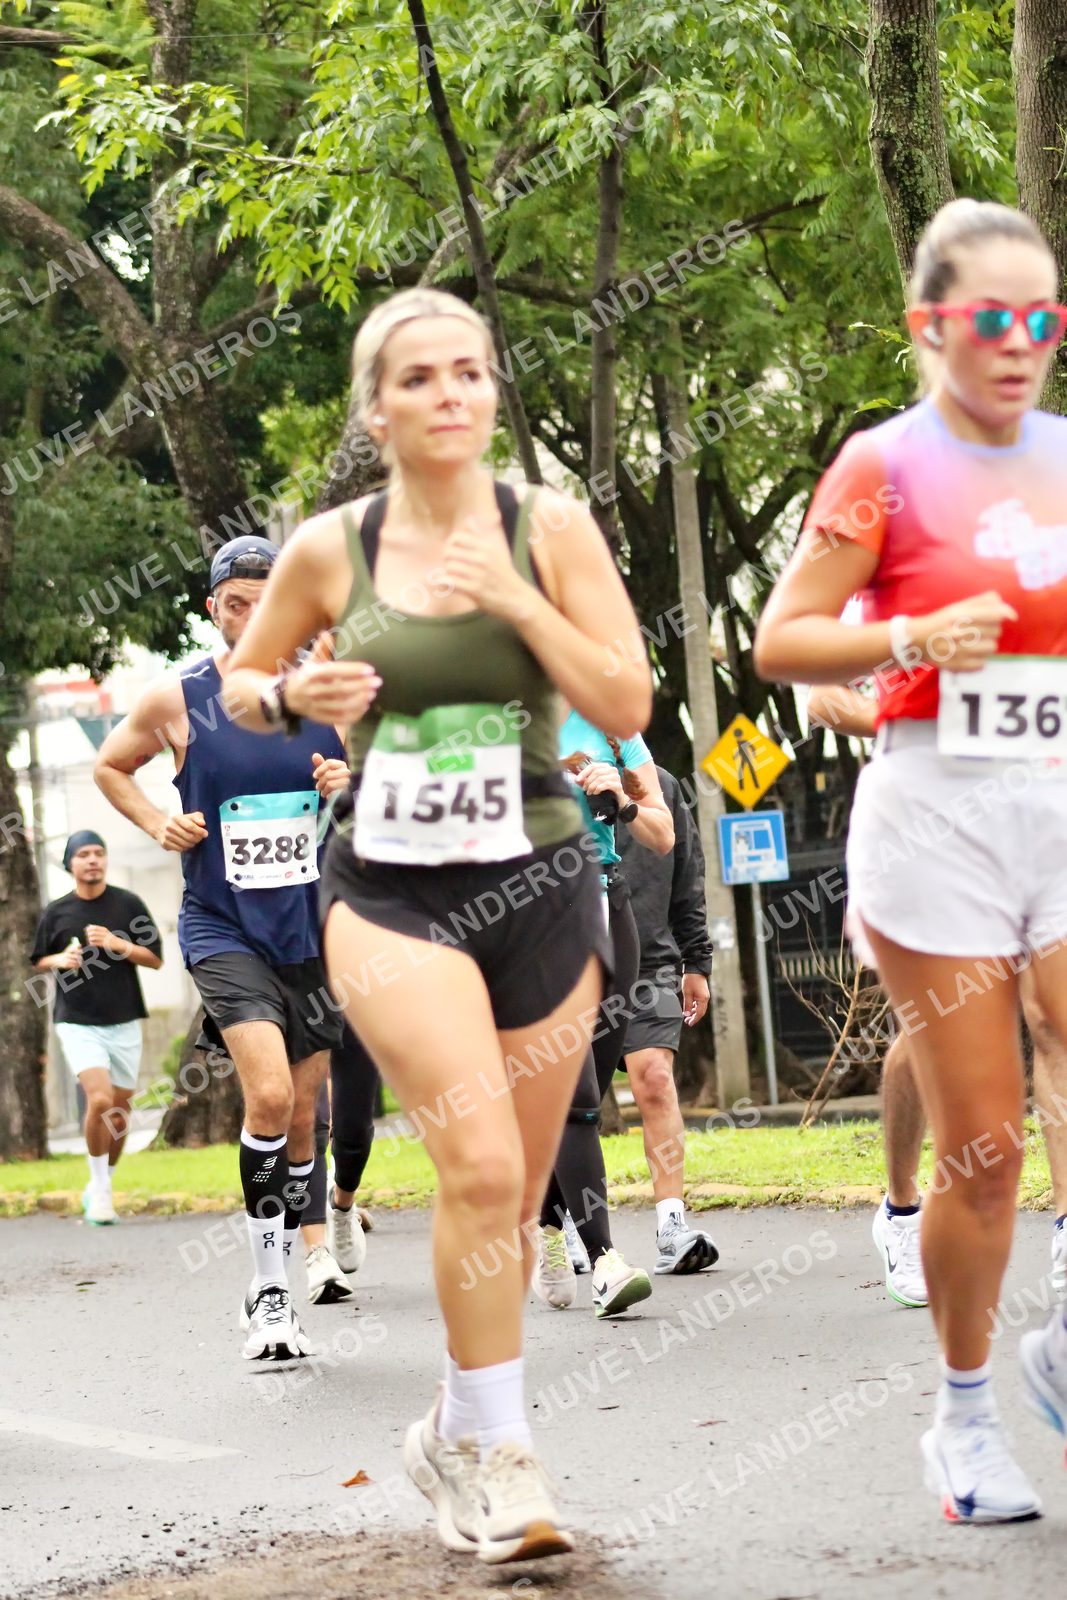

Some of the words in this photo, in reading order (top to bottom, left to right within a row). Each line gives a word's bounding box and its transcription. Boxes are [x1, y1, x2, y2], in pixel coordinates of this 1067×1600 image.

[961, 692, 1067, 739] 136
[382, 777, 507, 824] 1545
[230, 833, 310, 866] 3288
